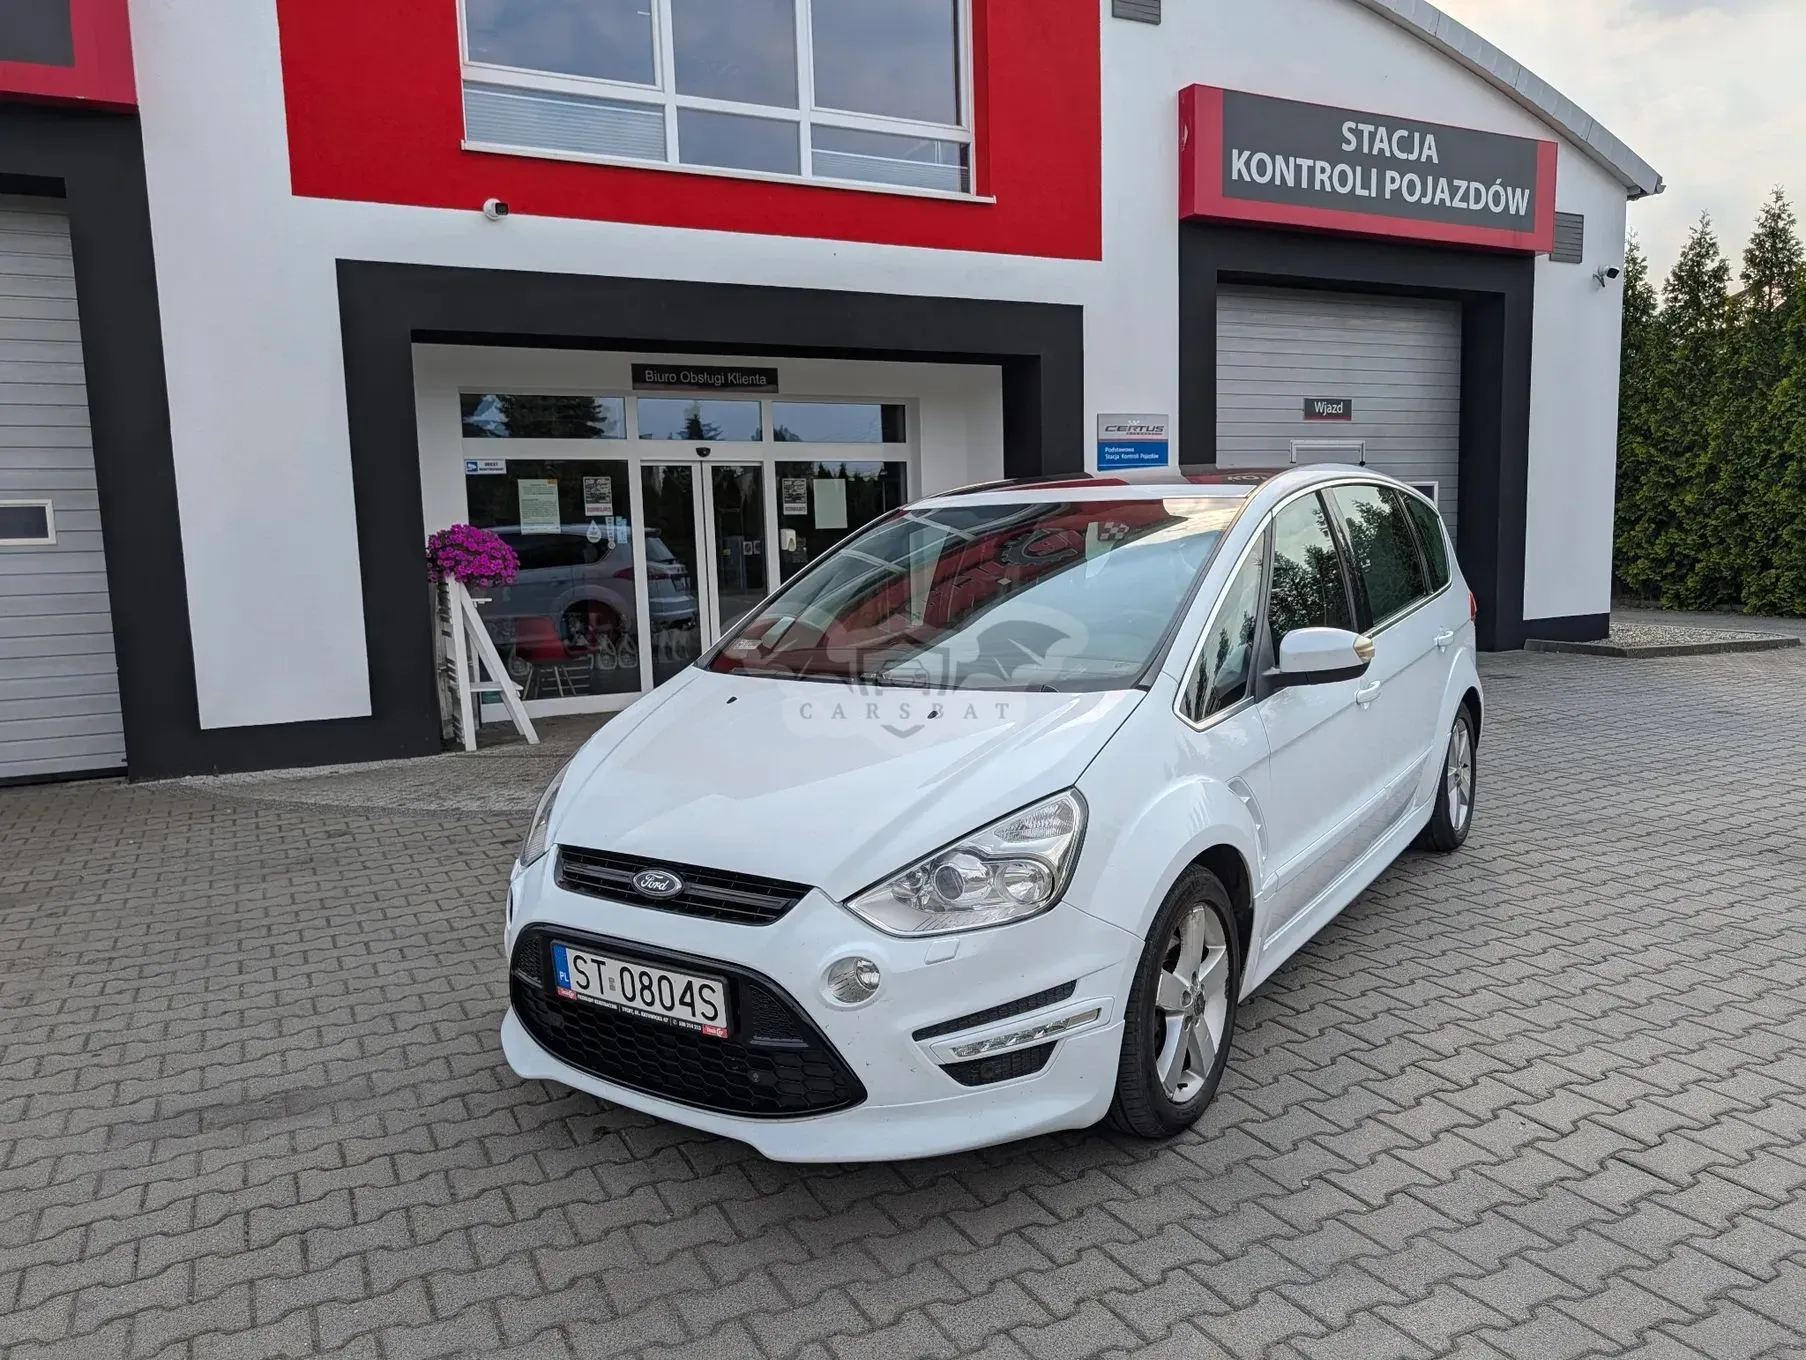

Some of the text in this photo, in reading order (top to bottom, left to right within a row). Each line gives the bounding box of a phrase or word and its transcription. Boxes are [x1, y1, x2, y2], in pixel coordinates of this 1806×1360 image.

[1341, 120, 1439, 164] STACJA
[1231, 148, 1531, 217] KONTROLI POJAZDÓW
[645, 370, 767, 386] Biuro Obsługi Klienta
[1314, 401, 1344, 416] Wjazd
[1105, 425, 1165, 433] CERTUS
[1104, 453, 1120, 461] Stacja
[641, 873, 669, 890] Ford
[559, 971, 569, 983] PL
[573, 954, 719, 1022] ST 0804S
